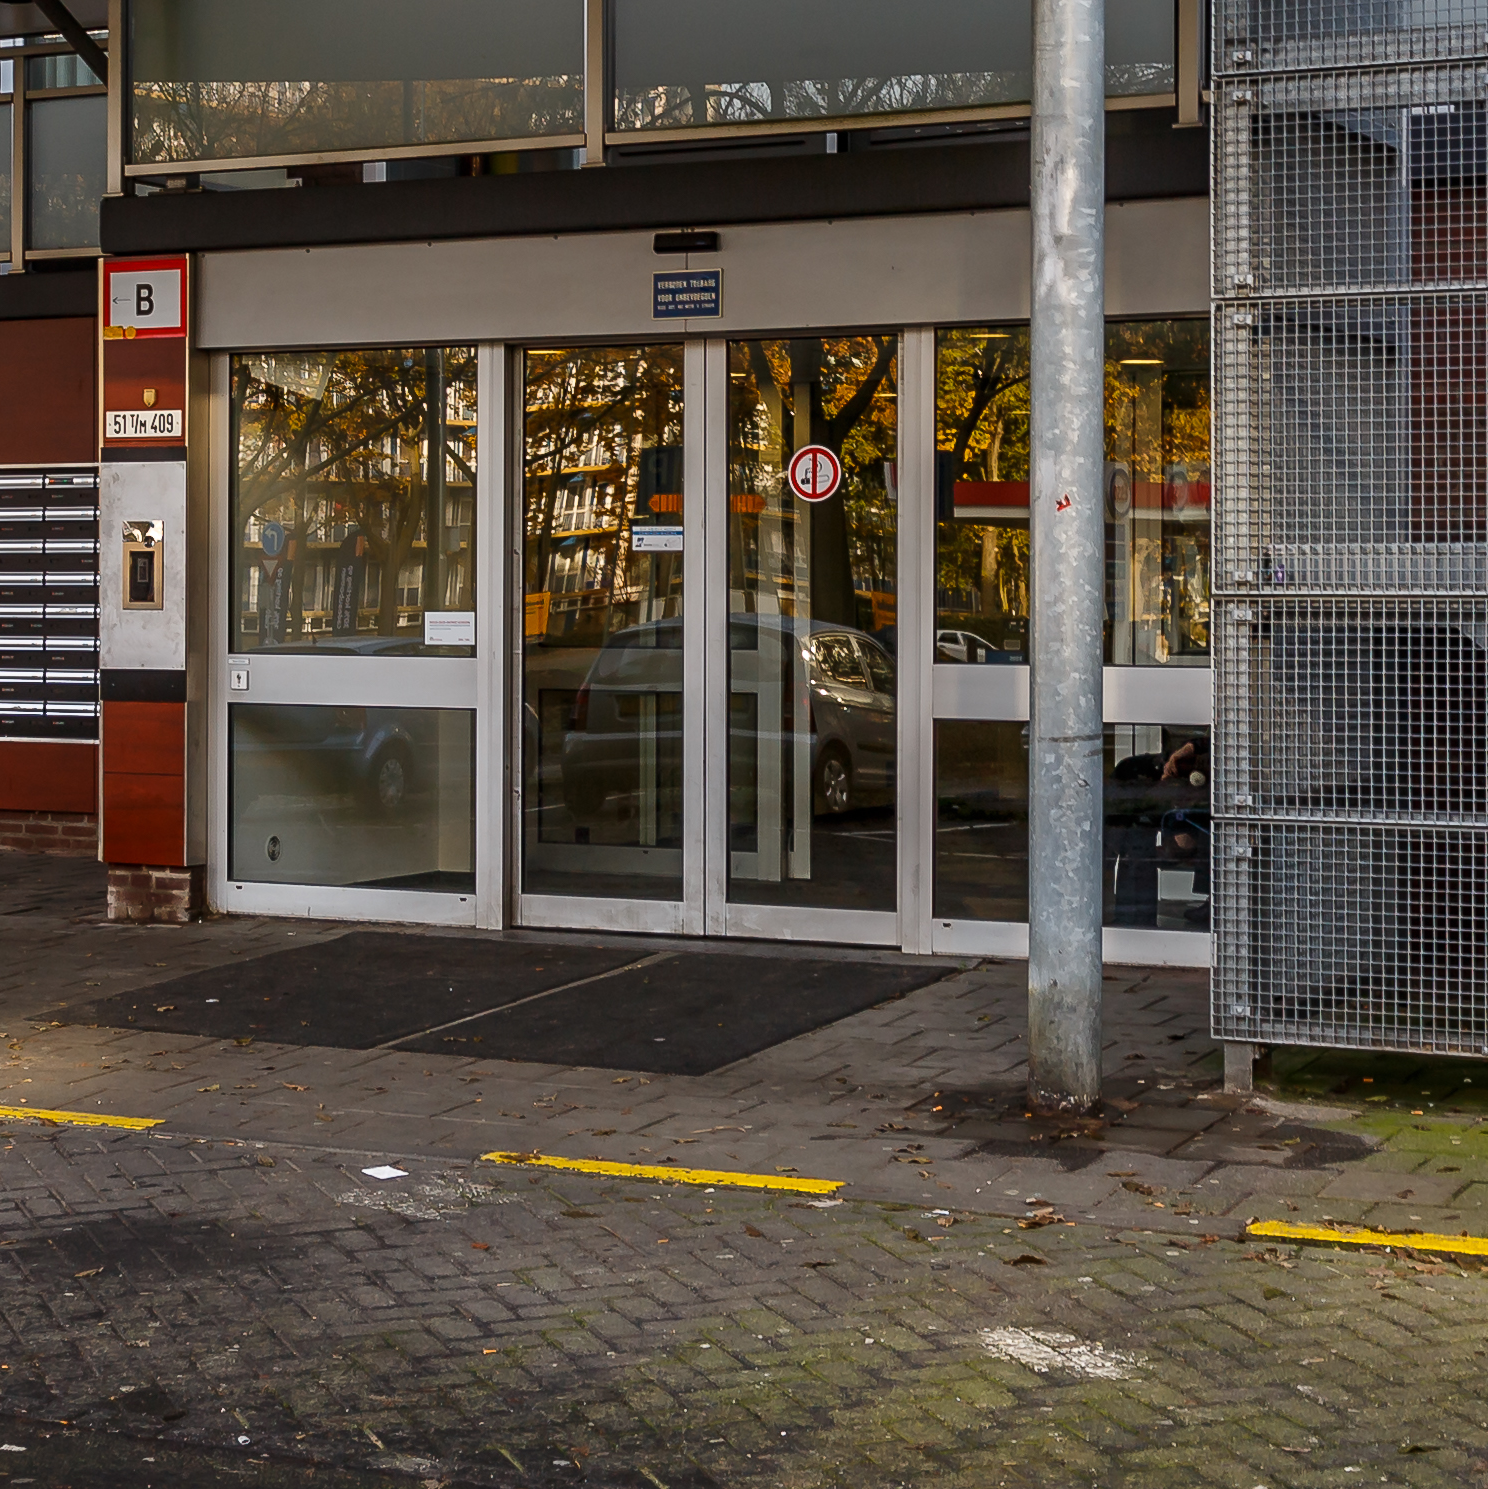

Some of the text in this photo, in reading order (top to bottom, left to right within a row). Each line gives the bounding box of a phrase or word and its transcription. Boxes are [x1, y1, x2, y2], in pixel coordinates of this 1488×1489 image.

[135, 283, 154, 316] B
[113, 414, 127, 434] 51
[150, 413, 174, 433] 409
